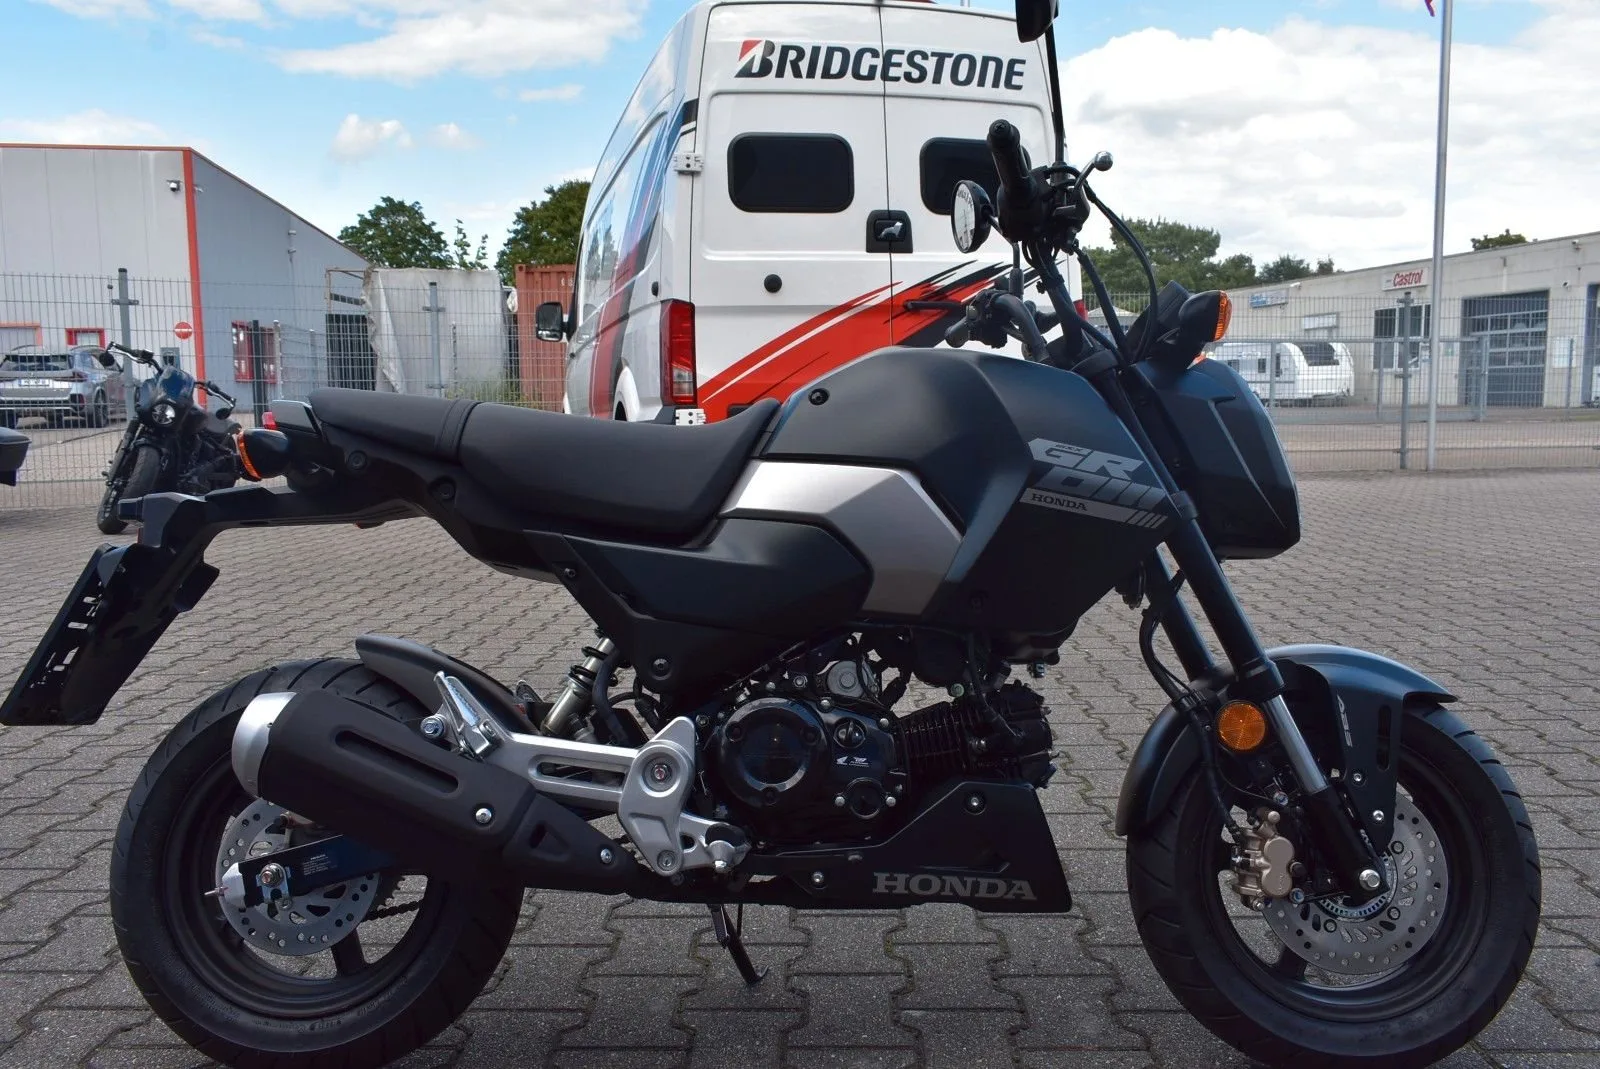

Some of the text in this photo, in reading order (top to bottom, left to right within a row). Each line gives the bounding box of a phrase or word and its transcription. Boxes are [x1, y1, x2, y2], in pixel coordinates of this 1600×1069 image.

[734, 39, 1027, 91] BRIDGESTONE
[1393, 269, 1423, 286] Castrol
[1031, 493, 1088, 512] HONDA
[872, 871, 1038, 901] HONDA
